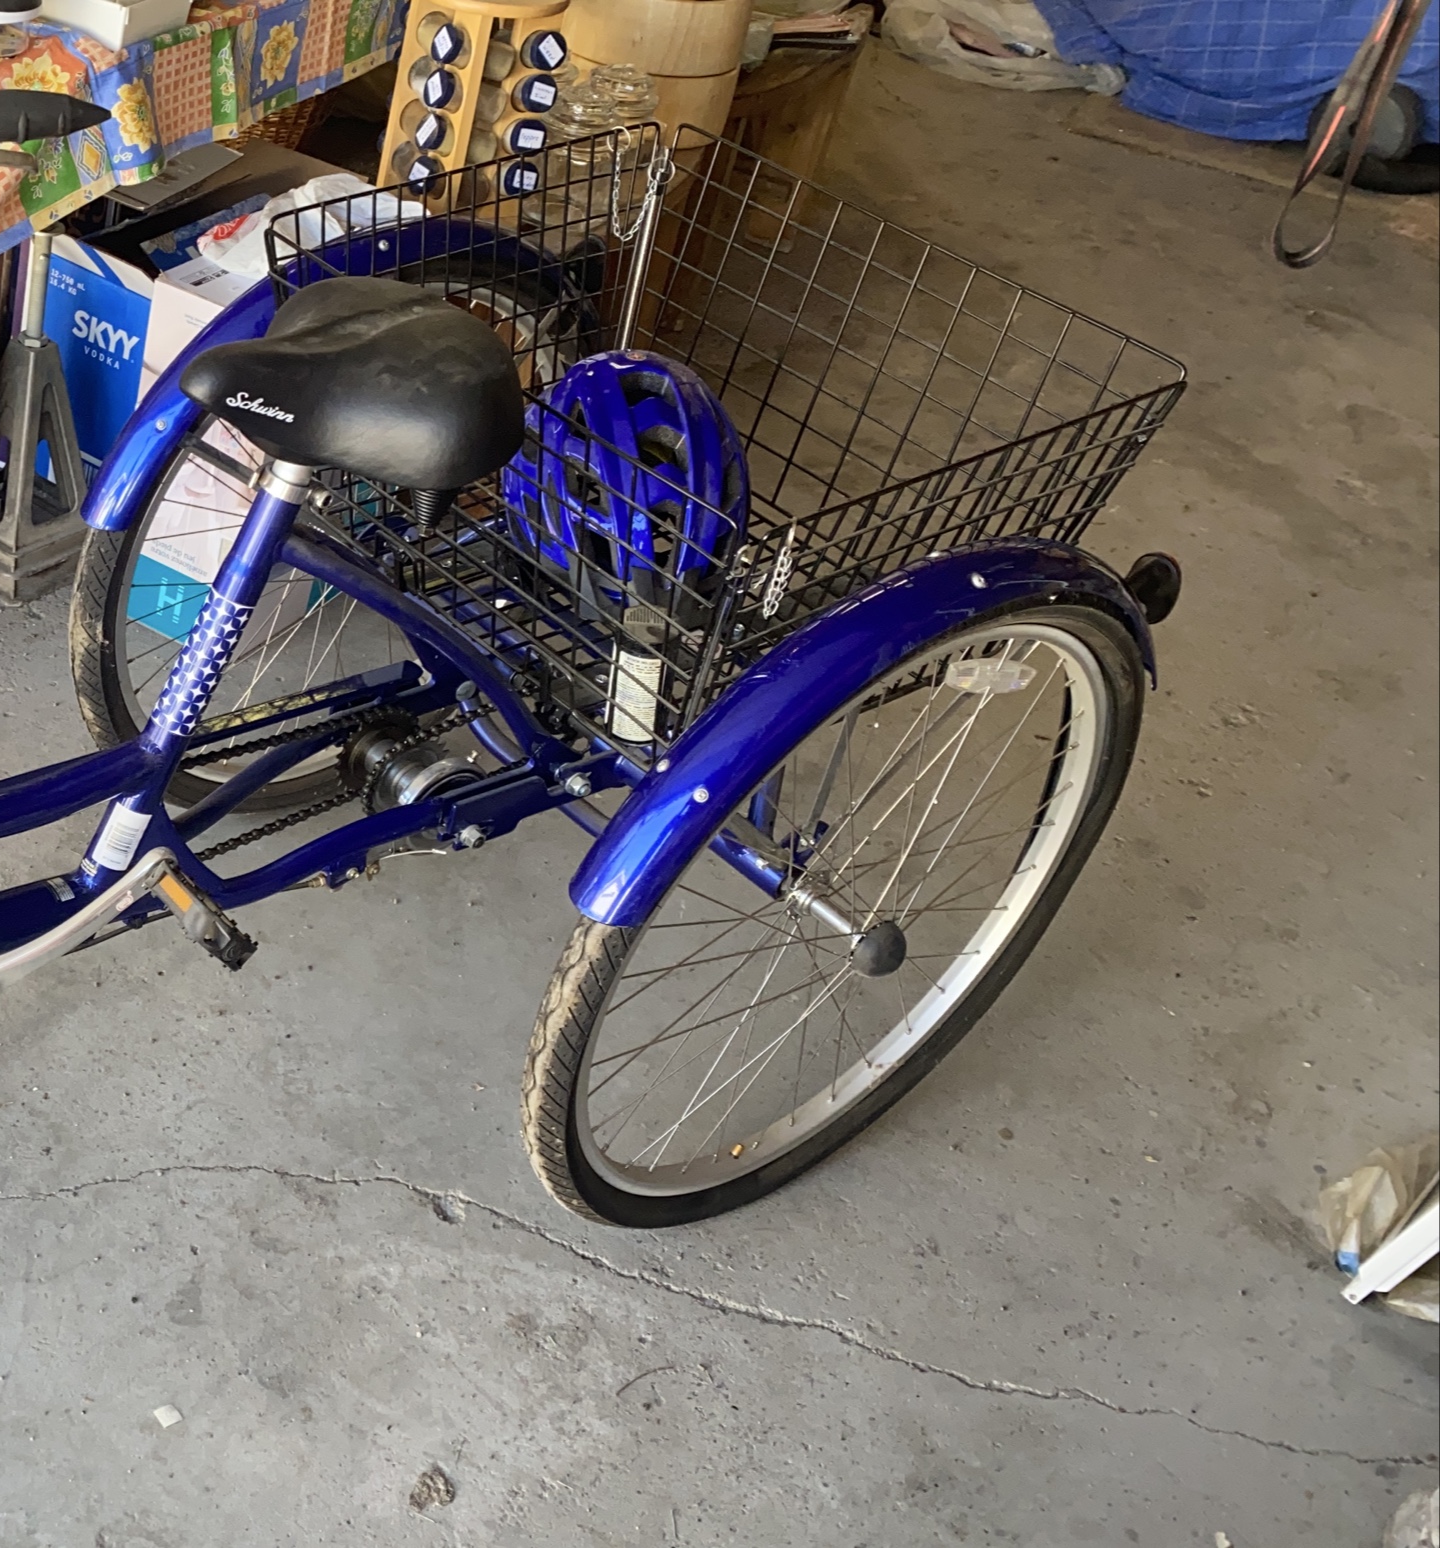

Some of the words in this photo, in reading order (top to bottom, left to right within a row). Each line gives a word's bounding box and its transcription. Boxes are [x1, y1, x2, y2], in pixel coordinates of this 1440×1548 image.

[71, 309, 140, 361] SKYY
[83, 345, 120, 370] VODKA
[225, 391, 295, 423] Schwinn
